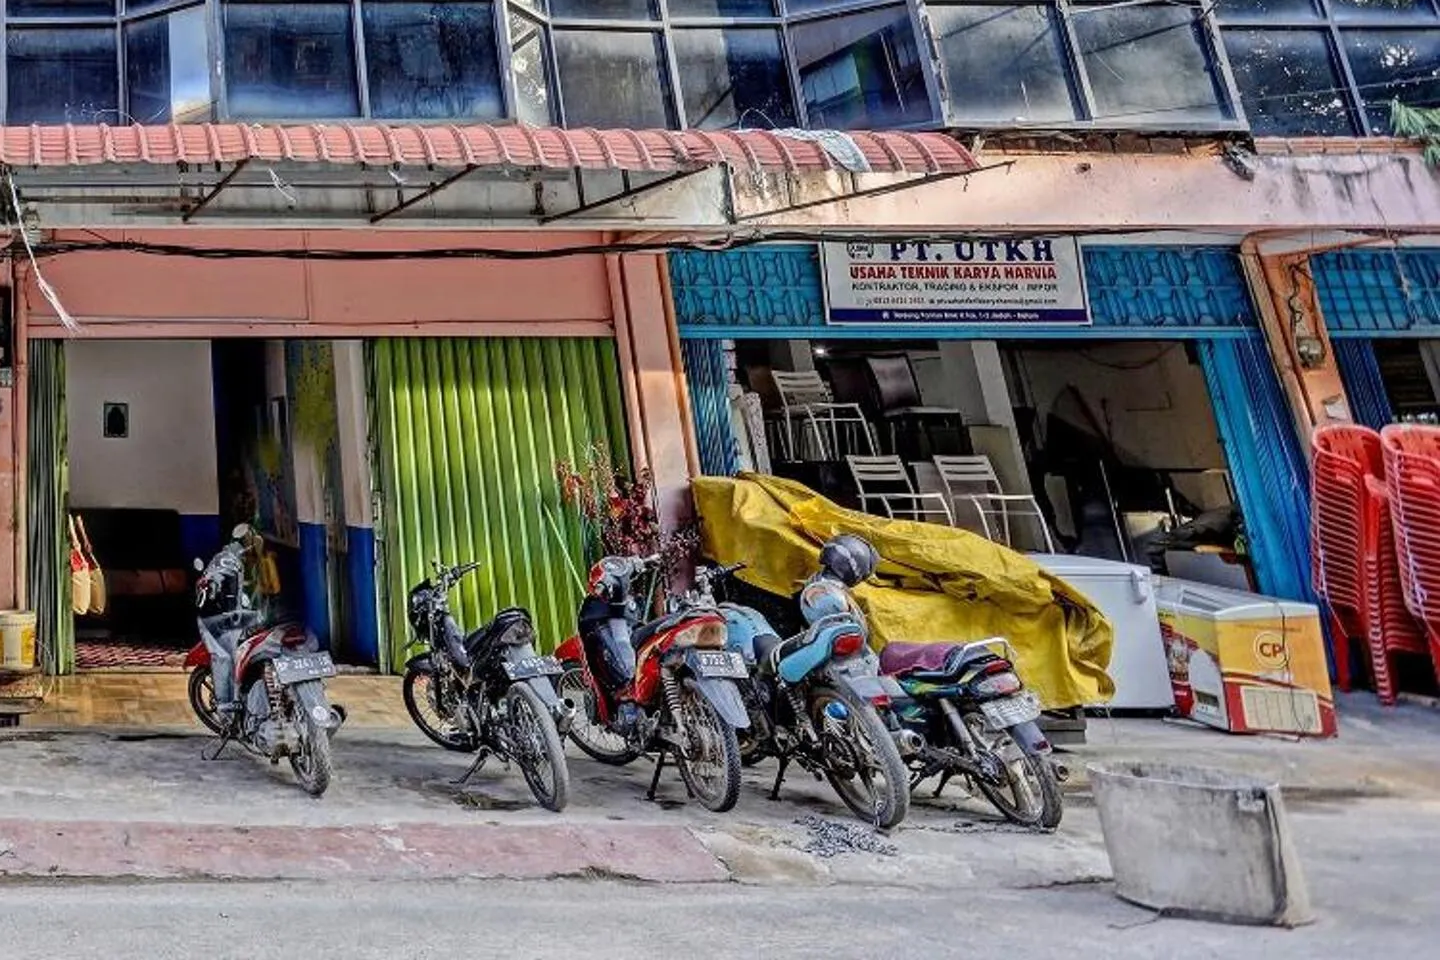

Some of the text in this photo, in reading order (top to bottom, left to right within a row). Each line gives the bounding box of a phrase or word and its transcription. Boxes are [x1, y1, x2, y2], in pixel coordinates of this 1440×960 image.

[955, 240, 1055, 261] UTKH
[850, 264, 896, 279] USAHA
[900, 264, 948, 279] TEKNIK
[954, 264, 1000, 279] KARYA
[1259, 642, 1283, 658] CP
